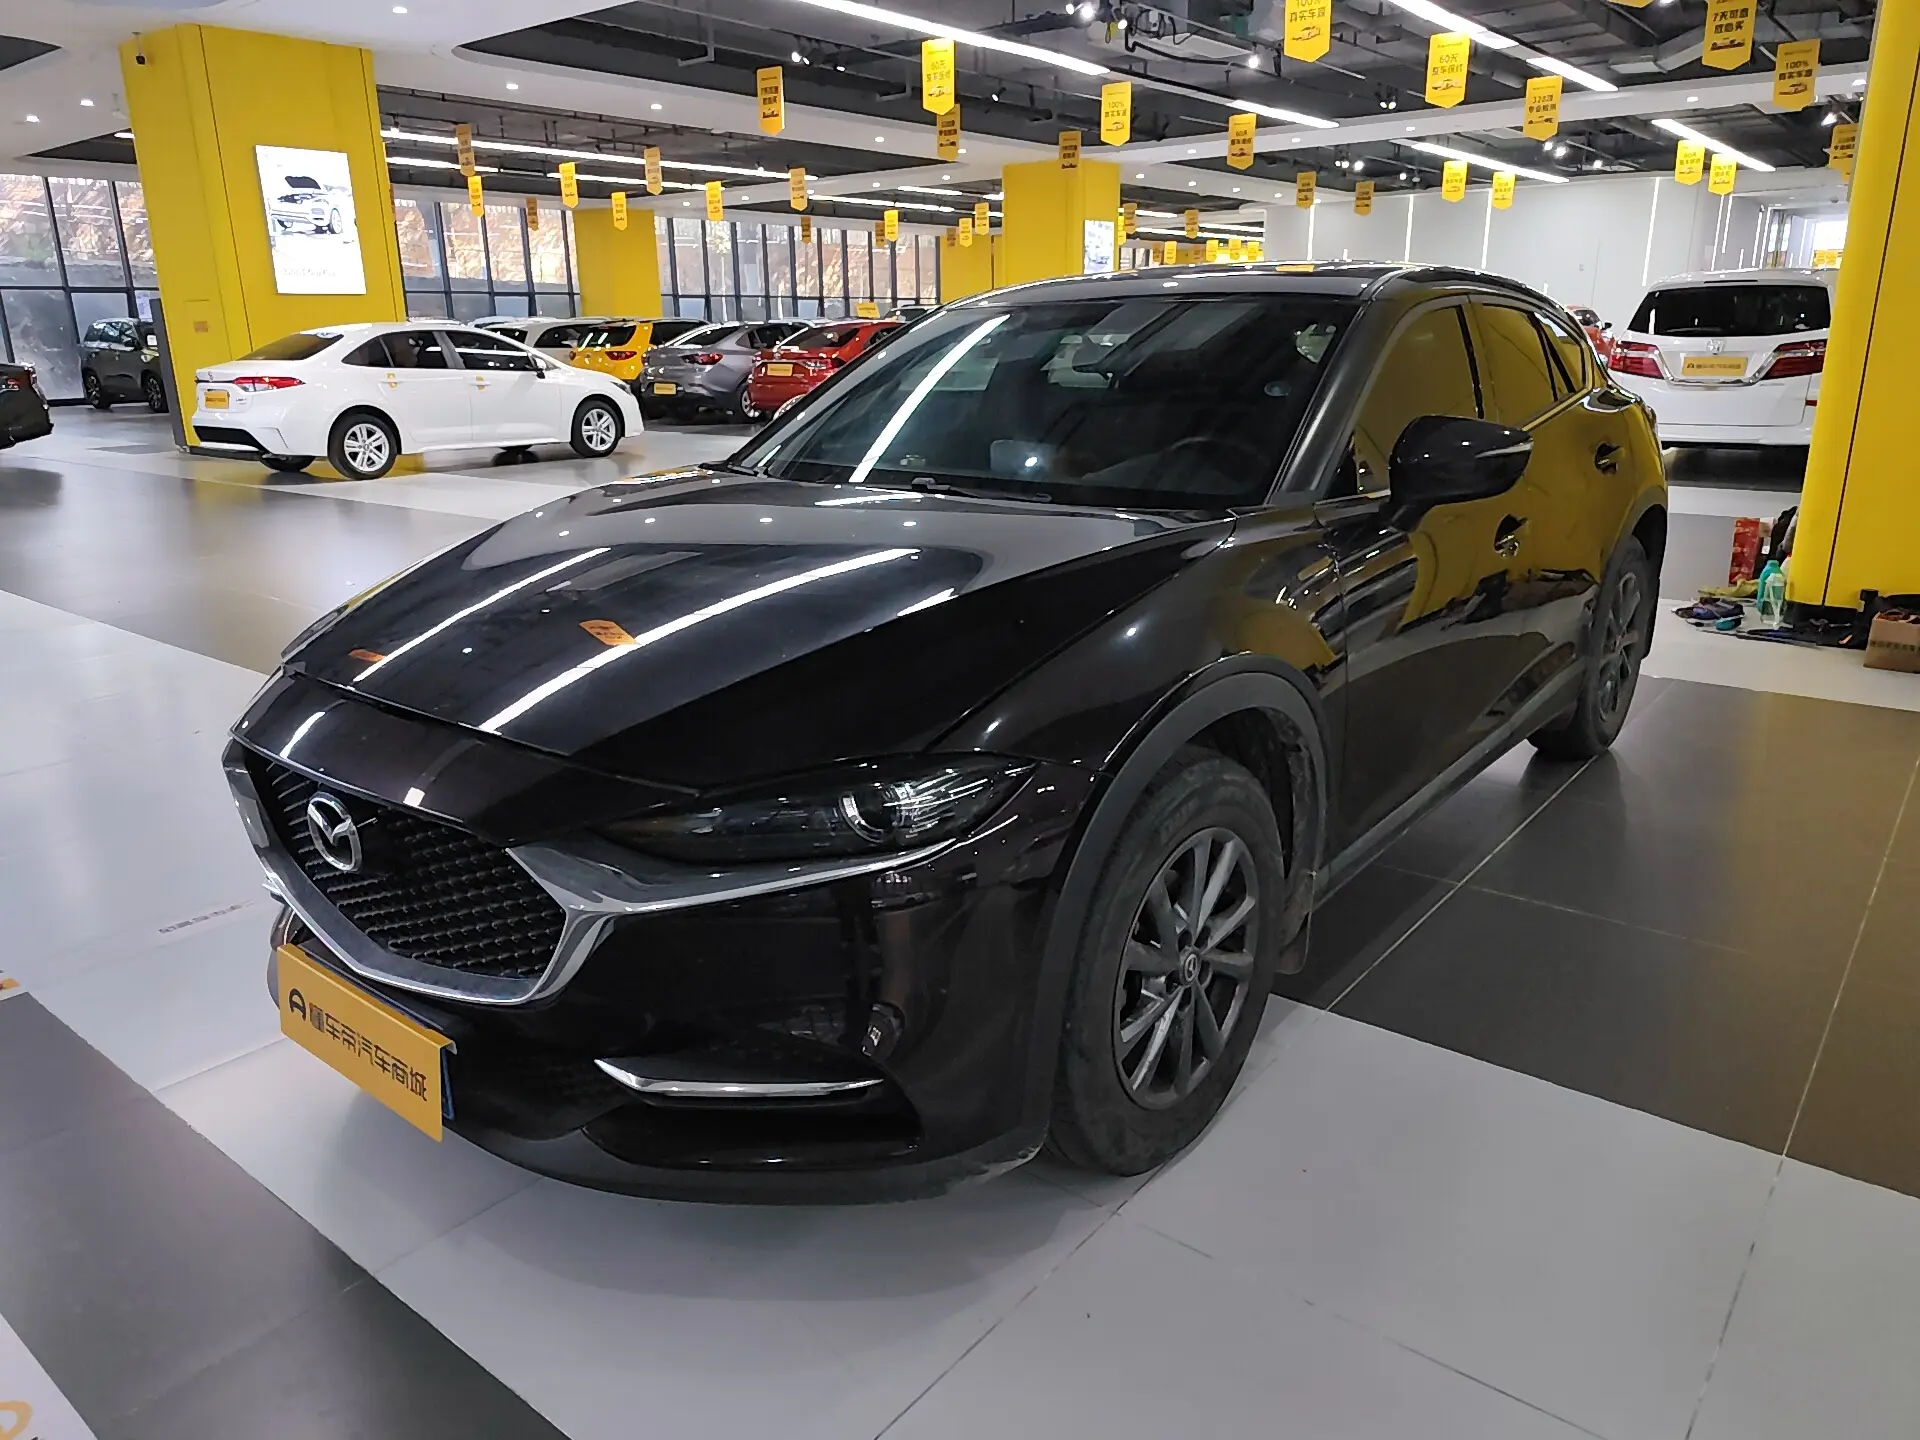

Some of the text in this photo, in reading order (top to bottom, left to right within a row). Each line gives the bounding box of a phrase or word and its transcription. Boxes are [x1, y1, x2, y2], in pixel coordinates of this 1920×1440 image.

[1439, 52, 1460, 64] 60天
[1785, 59, 1809, 69] 100%
[308, 1001, 428, 1102] 懂车帝汽车商城
